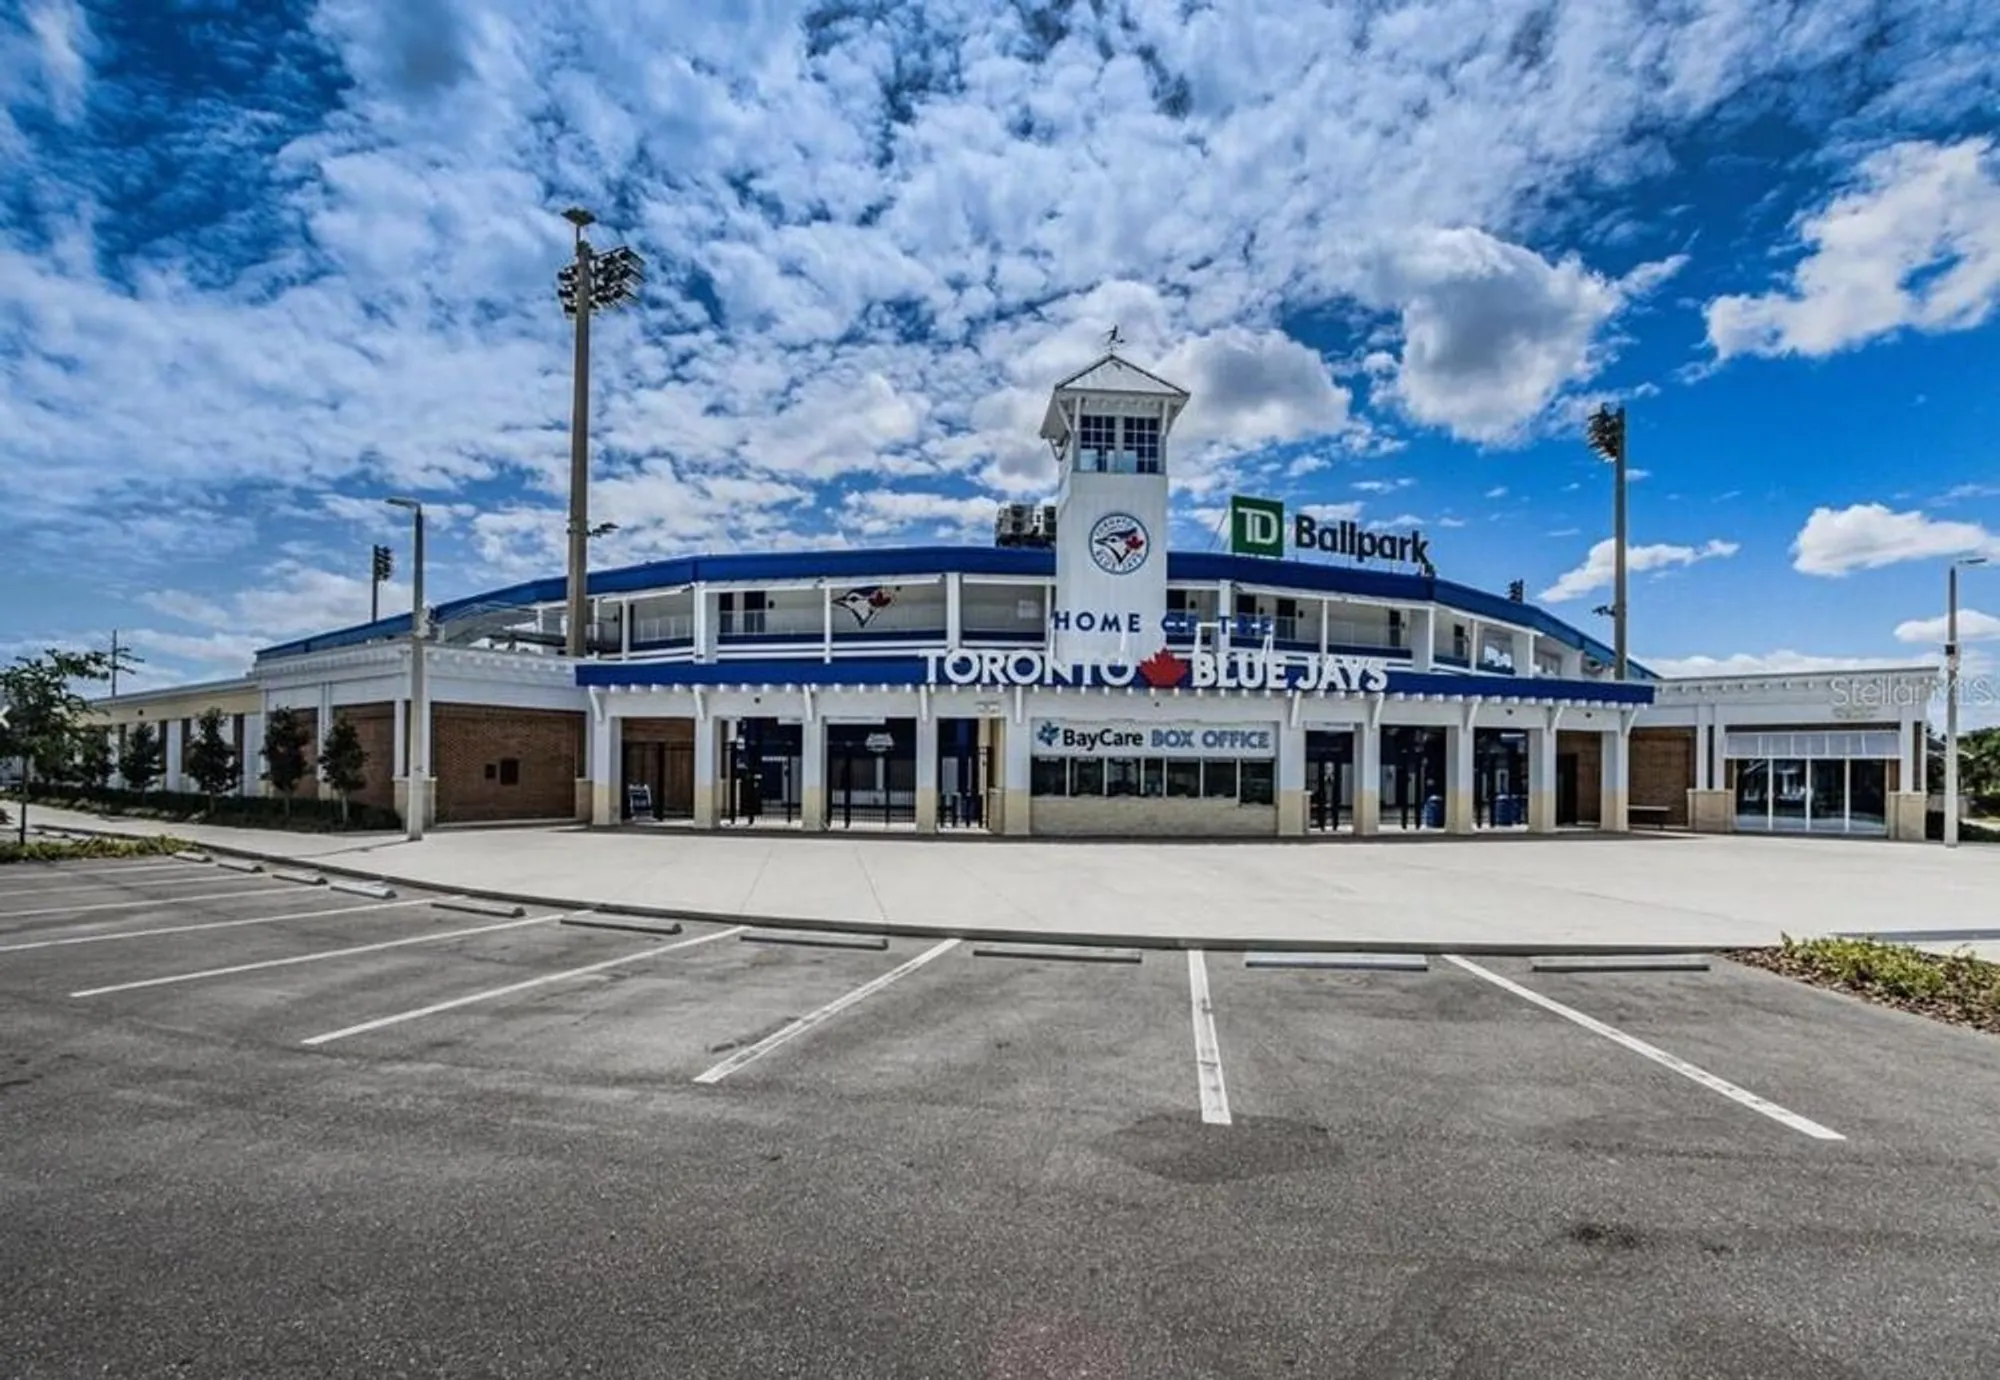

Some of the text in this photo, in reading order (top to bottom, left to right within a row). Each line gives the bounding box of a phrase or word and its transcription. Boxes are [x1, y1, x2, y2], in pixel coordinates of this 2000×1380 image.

[1236, 506, 1429, 564] TD Ballpark
[1054, 610, 1141, 633] HOME
[918, 648, 1388, 692] TORONTO BLUE JAYS
[1062, 729, 1270, 750] BayCare BOX OFFICE
